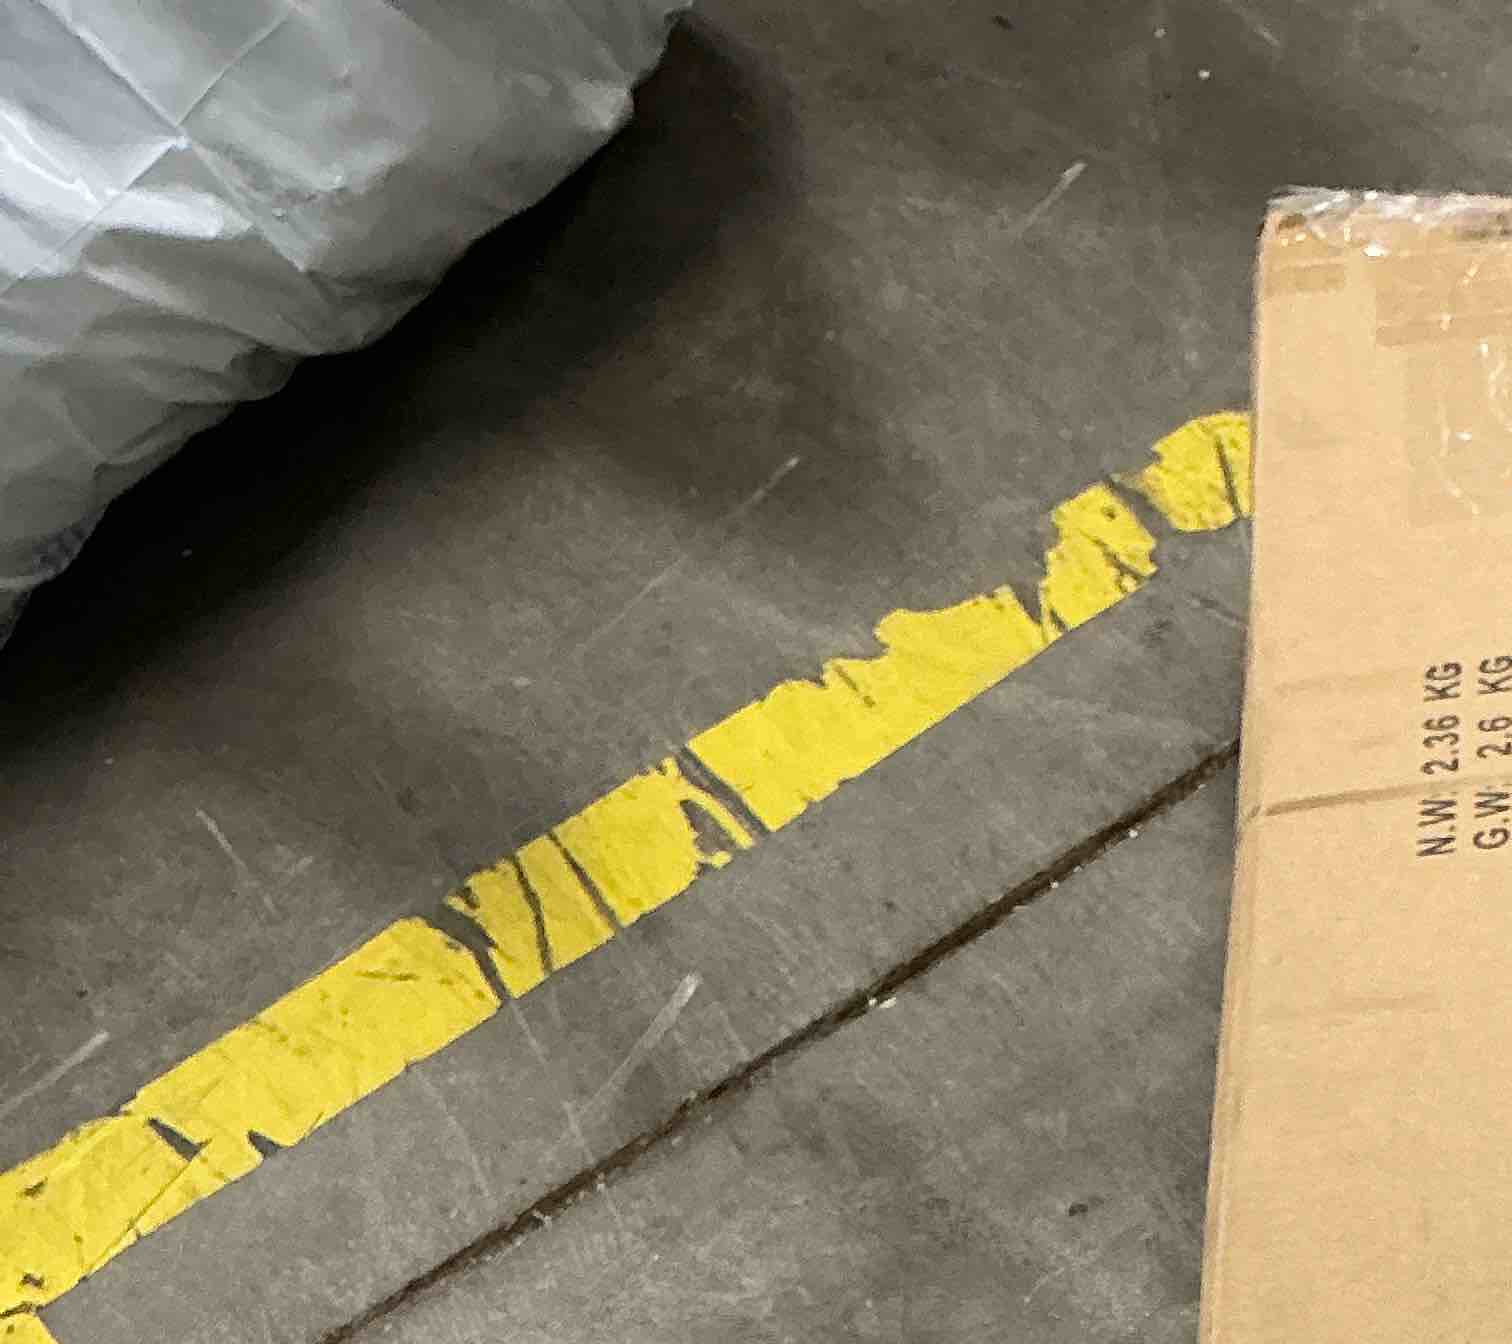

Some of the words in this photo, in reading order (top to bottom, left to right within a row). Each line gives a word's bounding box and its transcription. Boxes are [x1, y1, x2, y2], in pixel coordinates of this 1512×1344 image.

[1423, 662, 1462, 702] KG
[1478, 656, 1512, 695] KG
[1420, 715, 1460, 775] 2.36
[1476, 716, 1512, 759] 2.6
